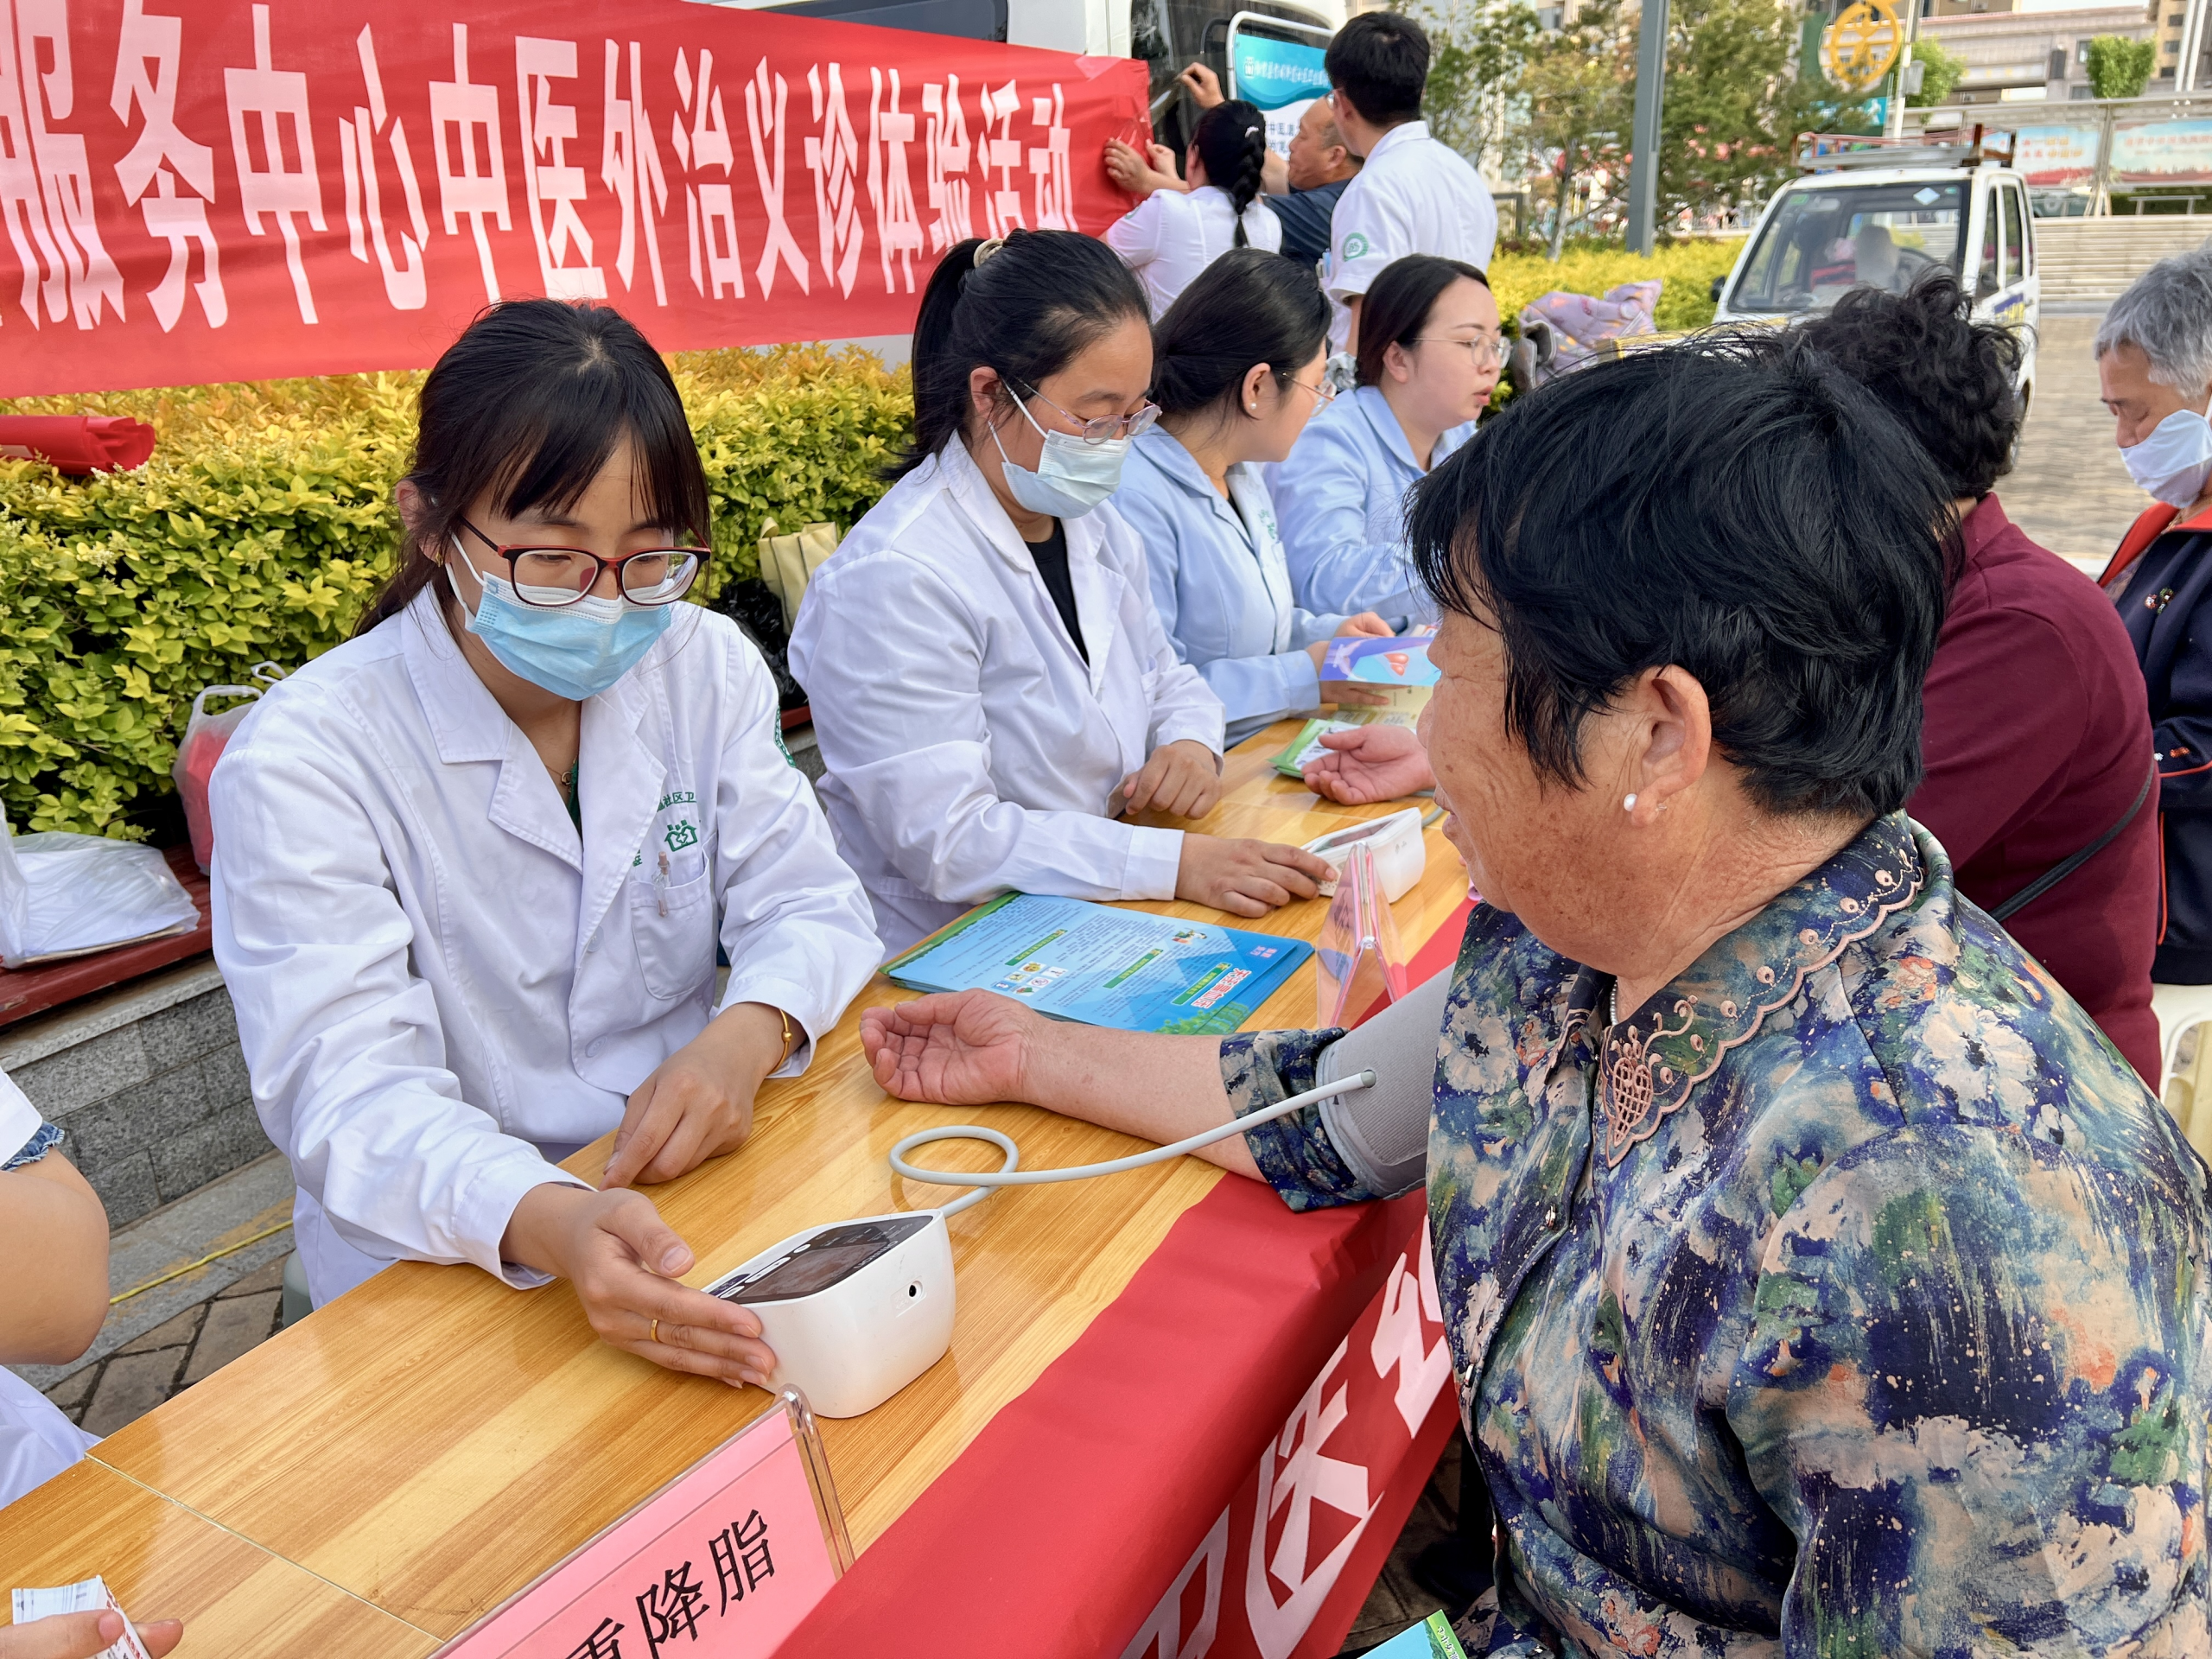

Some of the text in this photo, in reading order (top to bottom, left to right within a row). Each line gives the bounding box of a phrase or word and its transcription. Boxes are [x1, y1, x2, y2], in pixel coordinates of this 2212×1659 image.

[0, 0, 1078, 332] 服务中心中医外治义诊体验活动
[1191, 967, 1252, 1009] 关注高血压
